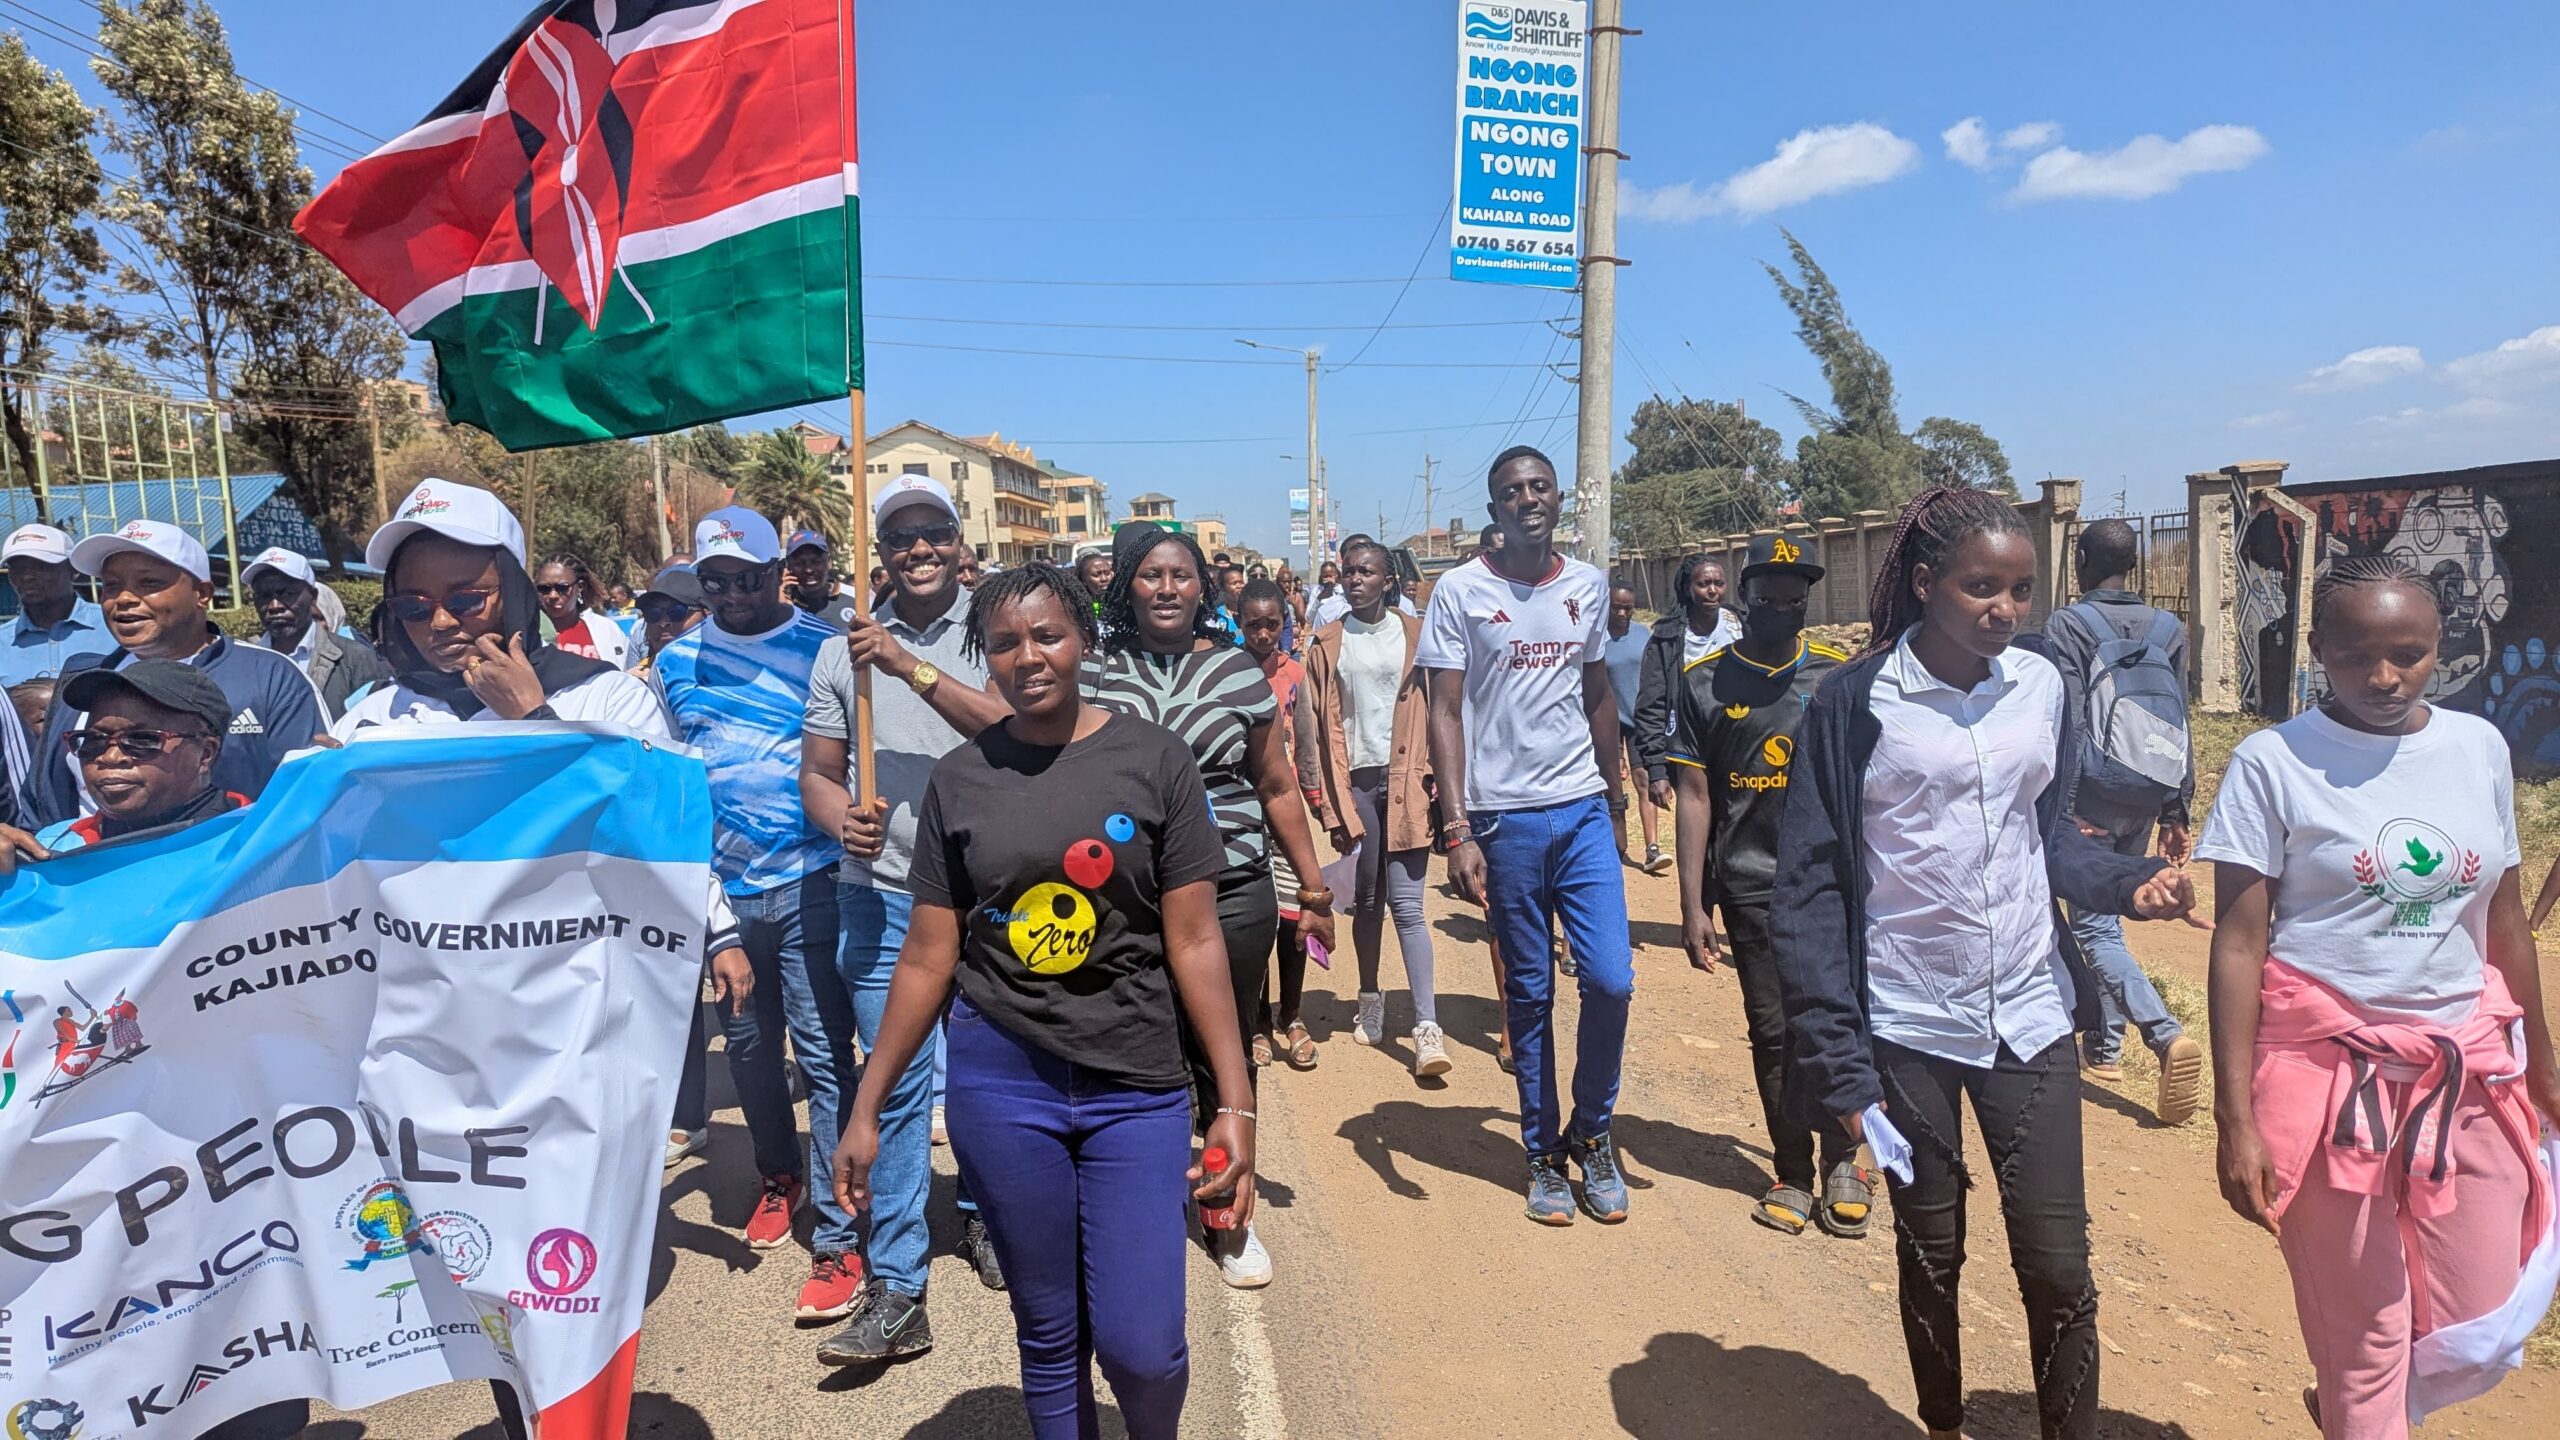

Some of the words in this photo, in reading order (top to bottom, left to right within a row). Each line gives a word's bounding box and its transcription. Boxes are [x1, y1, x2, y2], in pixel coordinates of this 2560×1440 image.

[1491, 7, 1509, 18] D&S
[1514, 8, 1557, 28] DAVIS
[1559, 12, 1570, 29] &
[1514, 27, 1583, 48] SHIRTLIFF
[1465, 40, 1485, 49] know
[1511, 44, 1540, 56] through
[1541, 48, 1582, 58] experience
[1469, 56, 1577, 88] NGONG
[1465, 85, 1579, 118] BRANCH
[1470, 121, 1569, 149] NGONG
[1480, 153, 1556, 178] TOWN
[1490, 187, 1545, 203] ALONG
[1463, 207, 1524, 224] KAHARA
[1529, 213, 1571, 227] ROAD
[1457, 235, 1499, 251] 0740
[1505, 238, 1537, 253] 567
[1543, 242, 1574, 256] 654
[1456, 255, 1573, 273] DavisandShirtliff.com
[1770, 538, 1800, 562] A's
[1509, 640, 1560, 656] Team
[1495, 652, 1560, 672] Viewer
[229, 724, 264, 734] adidas
[984, 907, 1030, 926] Triple
[2395, 901, 2406, 914] THE
[2406, 900, 2433, 914] WINGS
[2389, 914, 2401, 926] OF
[2401, 913, 2431, 927] PEACE
[186, 908, 362, 978] COUNTY
[373, 911, 631, 951] GOVERNMENT
[640, 925, 687, 953] OF
[2397, 930, 2407, 938] the
[1026, 922, 1095, 969] Zero
[193, 948, 377, 1012] KAJIADO
[424, 1211, 441, 1220] FOR
[443, 1210, 479, 1224] POSITIVE
[478, 1223, 492, 1261] MOVEMENT
[45, 1220, 299, 1351] KANCO
[507, 1290, 600, 1314] GIWODI
[48, 1340, 103, 1365] Healthy
[109, 1319, 160, 1343] people,
[165, 1276, 239, 1320] empowered
[327, 1341, 382, 1364] Tree
[387, 1322, 481, 1347] Concern
[365, 1357, 387, 1369] Save
[388, 1349, 412, 1362] Plant
[127, 1321, 322, 1428] KASHA
